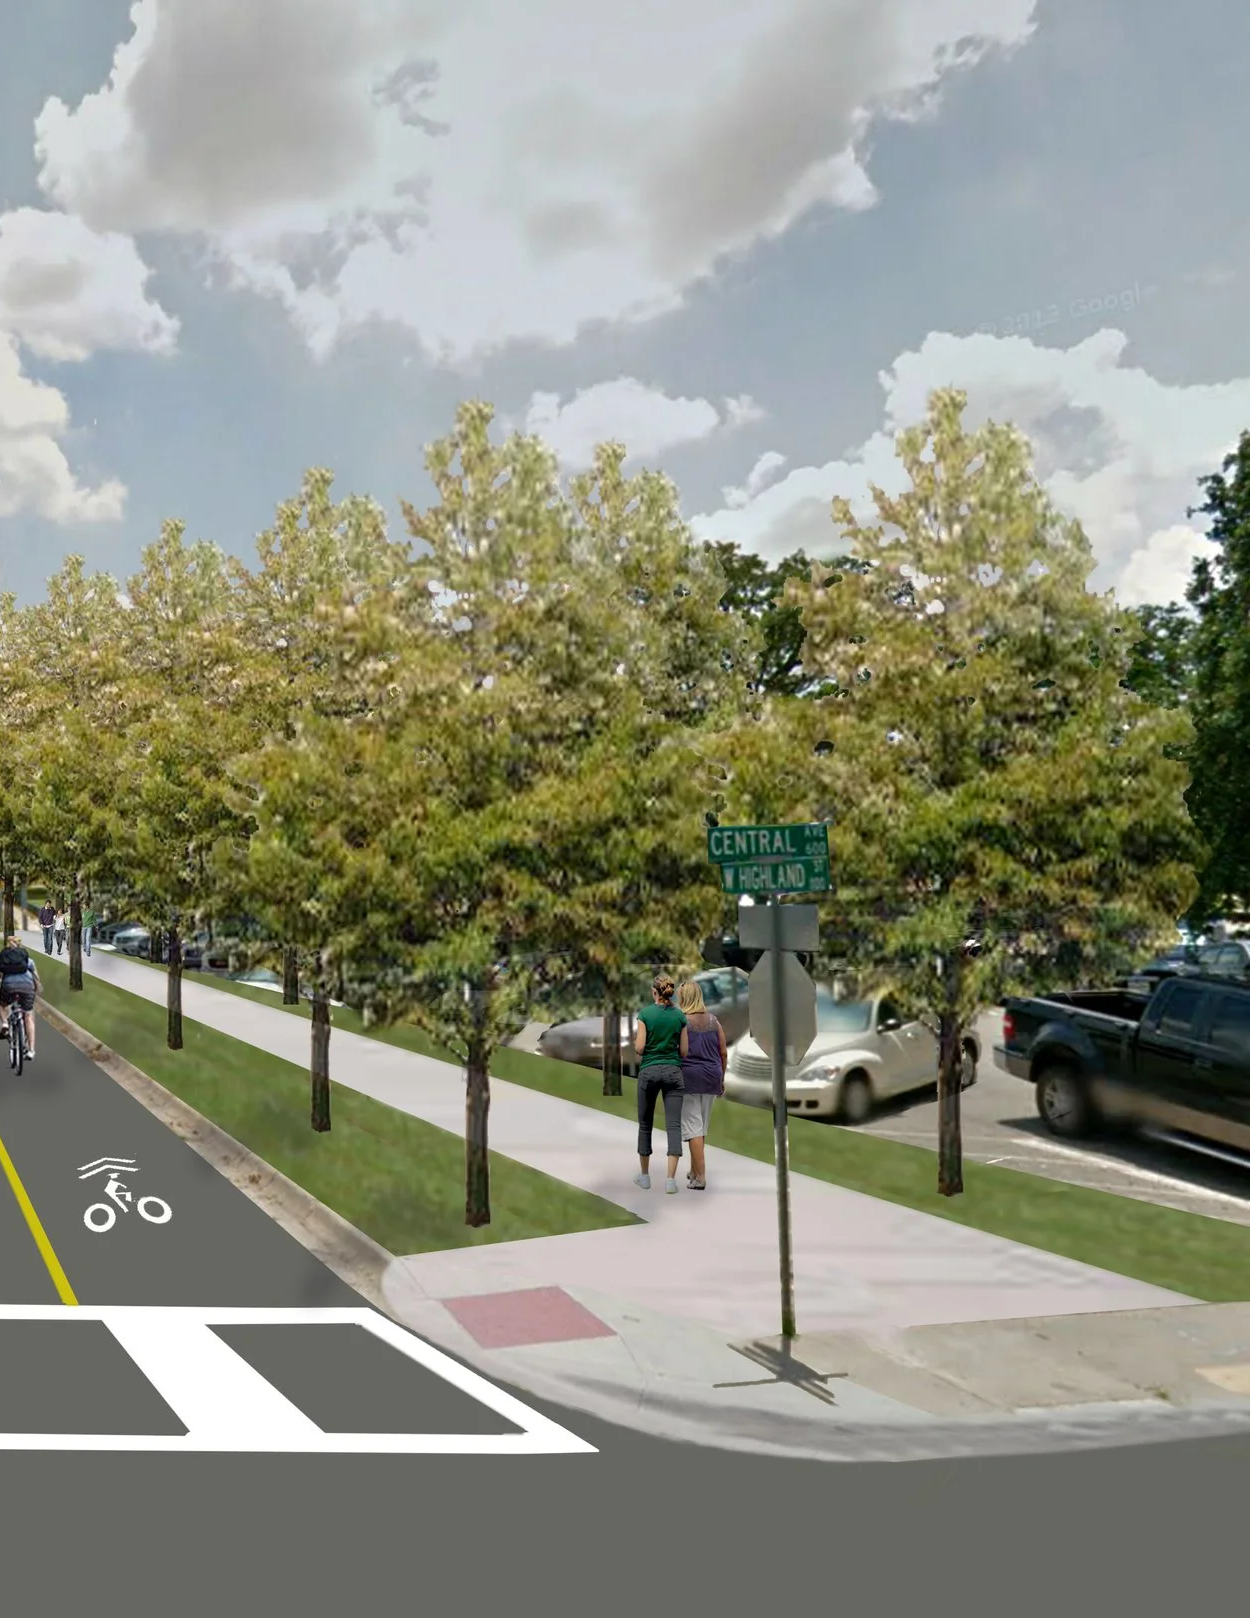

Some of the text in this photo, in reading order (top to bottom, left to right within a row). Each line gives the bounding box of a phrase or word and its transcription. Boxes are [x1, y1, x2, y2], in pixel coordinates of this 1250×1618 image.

[710, 825, 825, 855] CENTRAL AVE
[724, 860, 824, 890] W HIGHLAND ST
